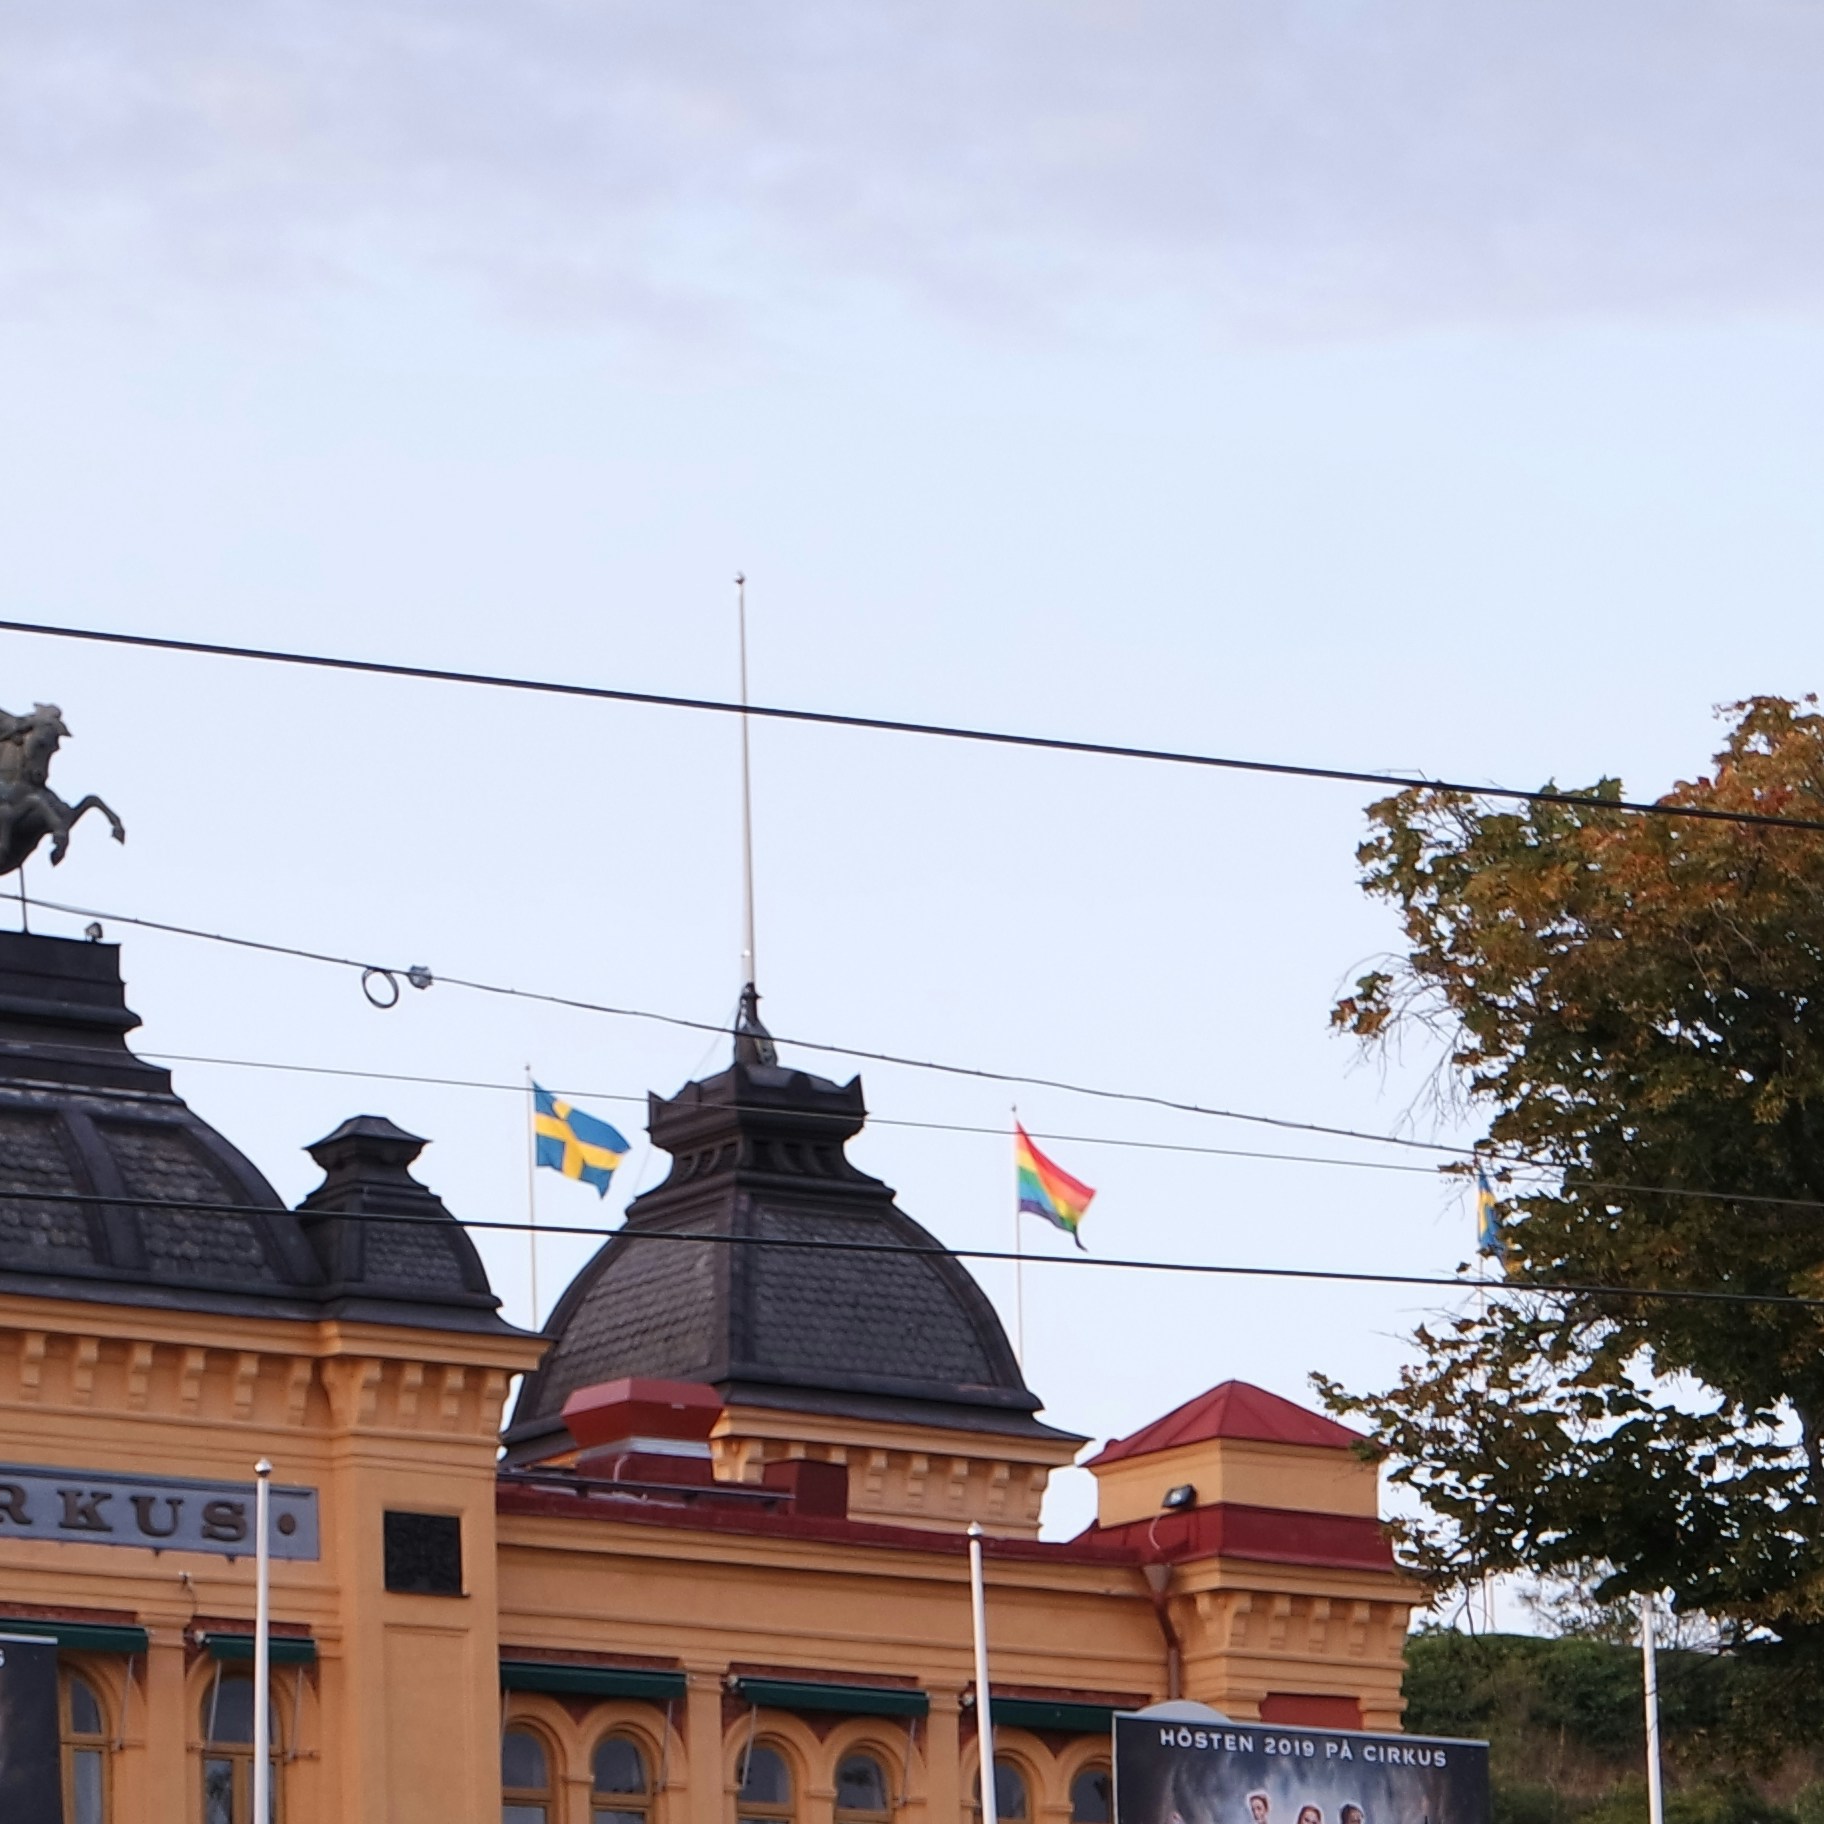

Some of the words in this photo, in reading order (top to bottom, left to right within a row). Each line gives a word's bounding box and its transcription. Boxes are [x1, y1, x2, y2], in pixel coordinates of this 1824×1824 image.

[1160, 1727, 1254, 1753] HÖSTEN
[1263, 1736, 1315, 1757] 2019
[1326, 1738, 1354, 1761] PÅ
[1362, 1745, 1447, 1768] CIRKUS
